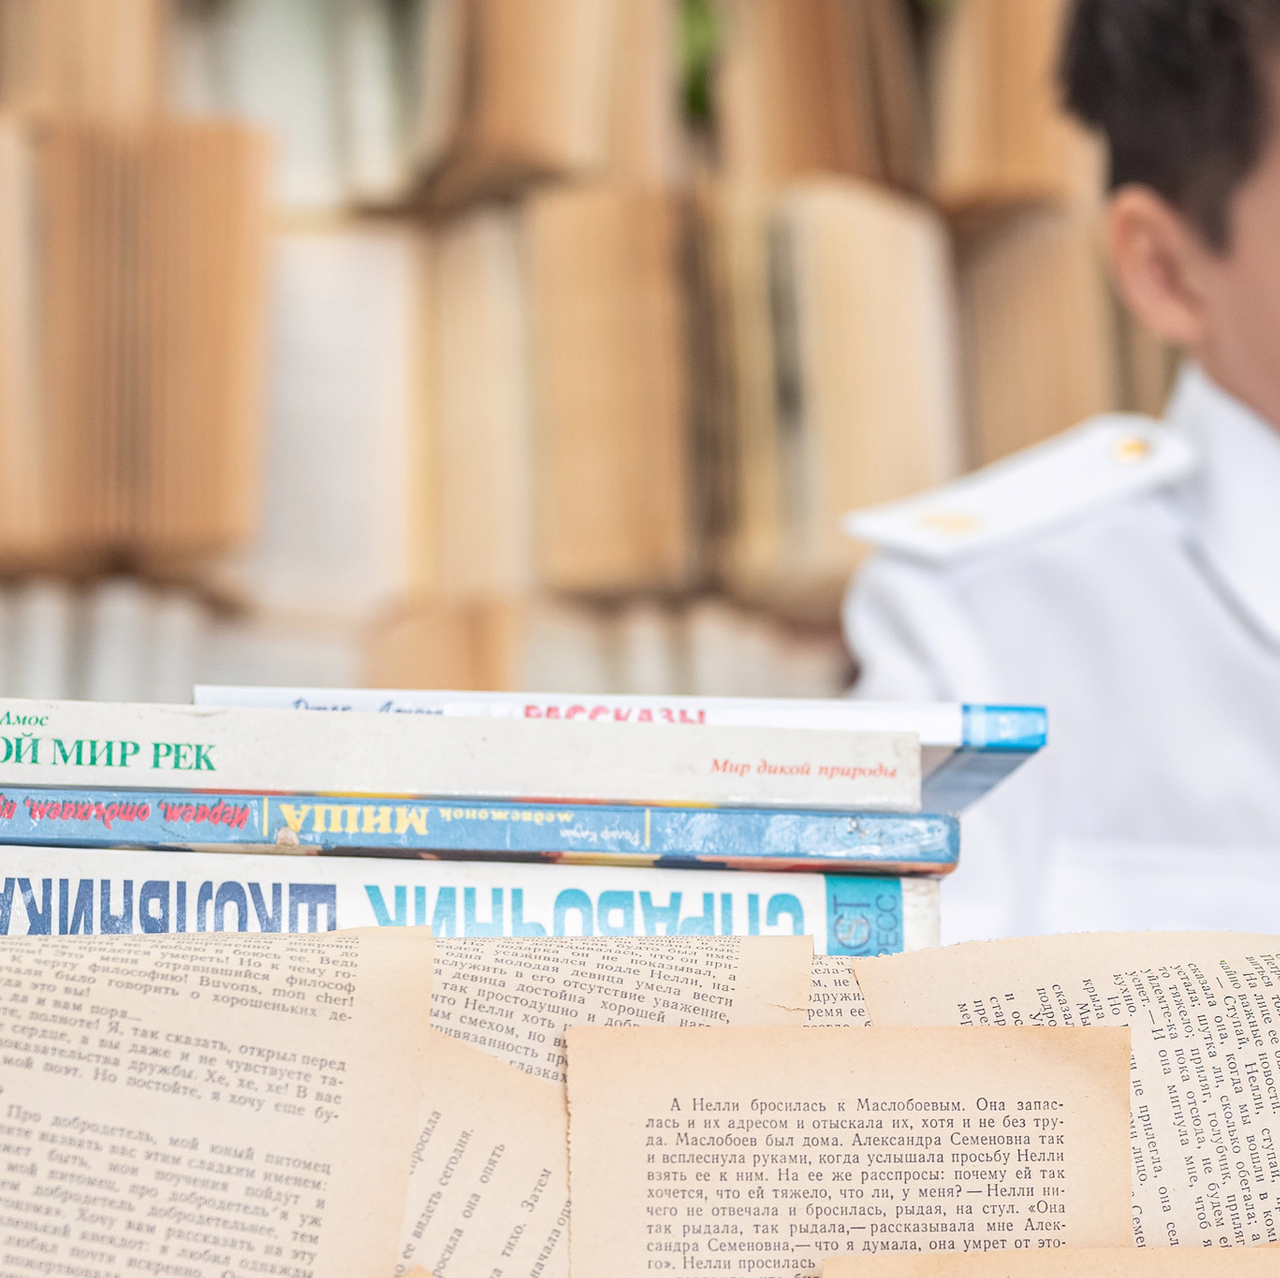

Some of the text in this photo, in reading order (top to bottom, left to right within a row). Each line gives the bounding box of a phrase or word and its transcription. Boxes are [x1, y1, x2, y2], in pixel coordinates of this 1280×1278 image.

[51, 738, 140, 768] МИР
[149, 742, 217, 771] РЕК
[710, 757, 898, 780] Мир дикой природы
[24, 795, 250, 831] Играем, отдыхаем,
[279, 803, 575, 836] медвежонок МИША
[670, 1097, 1063, 1114] А Нелли бросилась к Маслобоевым. Она запас-
[645, 1114, 1063, 1132] лась и их адресом и отыскала их, хотя и не без тру-
[645, 1131, 1064, 1149] да. Маслобоев был дома. Александра Семеновна так
